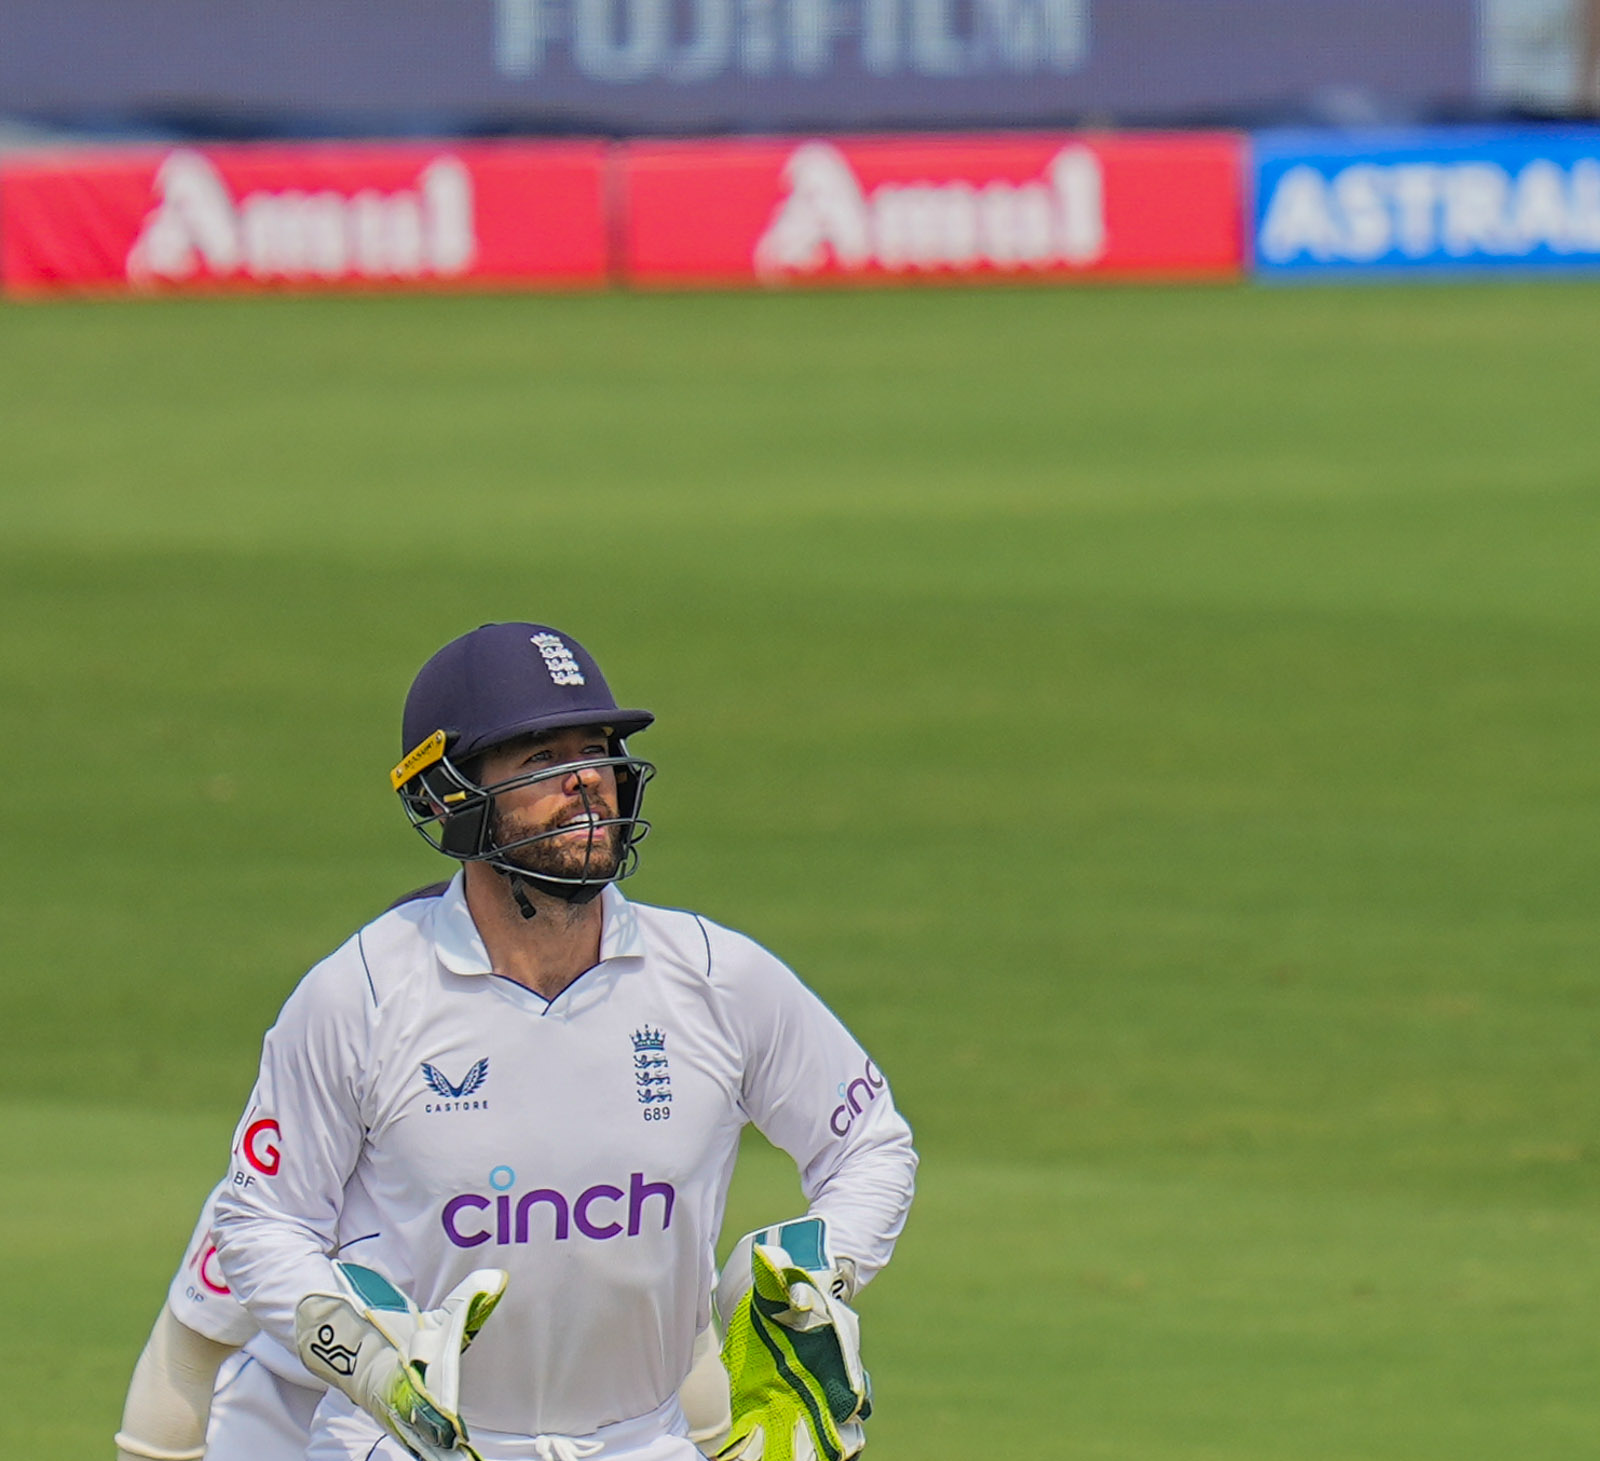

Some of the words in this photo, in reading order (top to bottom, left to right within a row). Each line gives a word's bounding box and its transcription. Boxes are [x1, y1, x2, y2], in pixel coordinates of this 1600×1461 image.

[127, 148, 477, 284] Amul
[753, 140, 1106, 283] Amul
[425, 1100, 489, 1113] CASTORE
[643, 1106, 670, 1121] 689
[830, 1057, 884, 1137] cinc
[233, 1171, 256, 1188] BF
[442, 1164, 676, 1248] cinch
